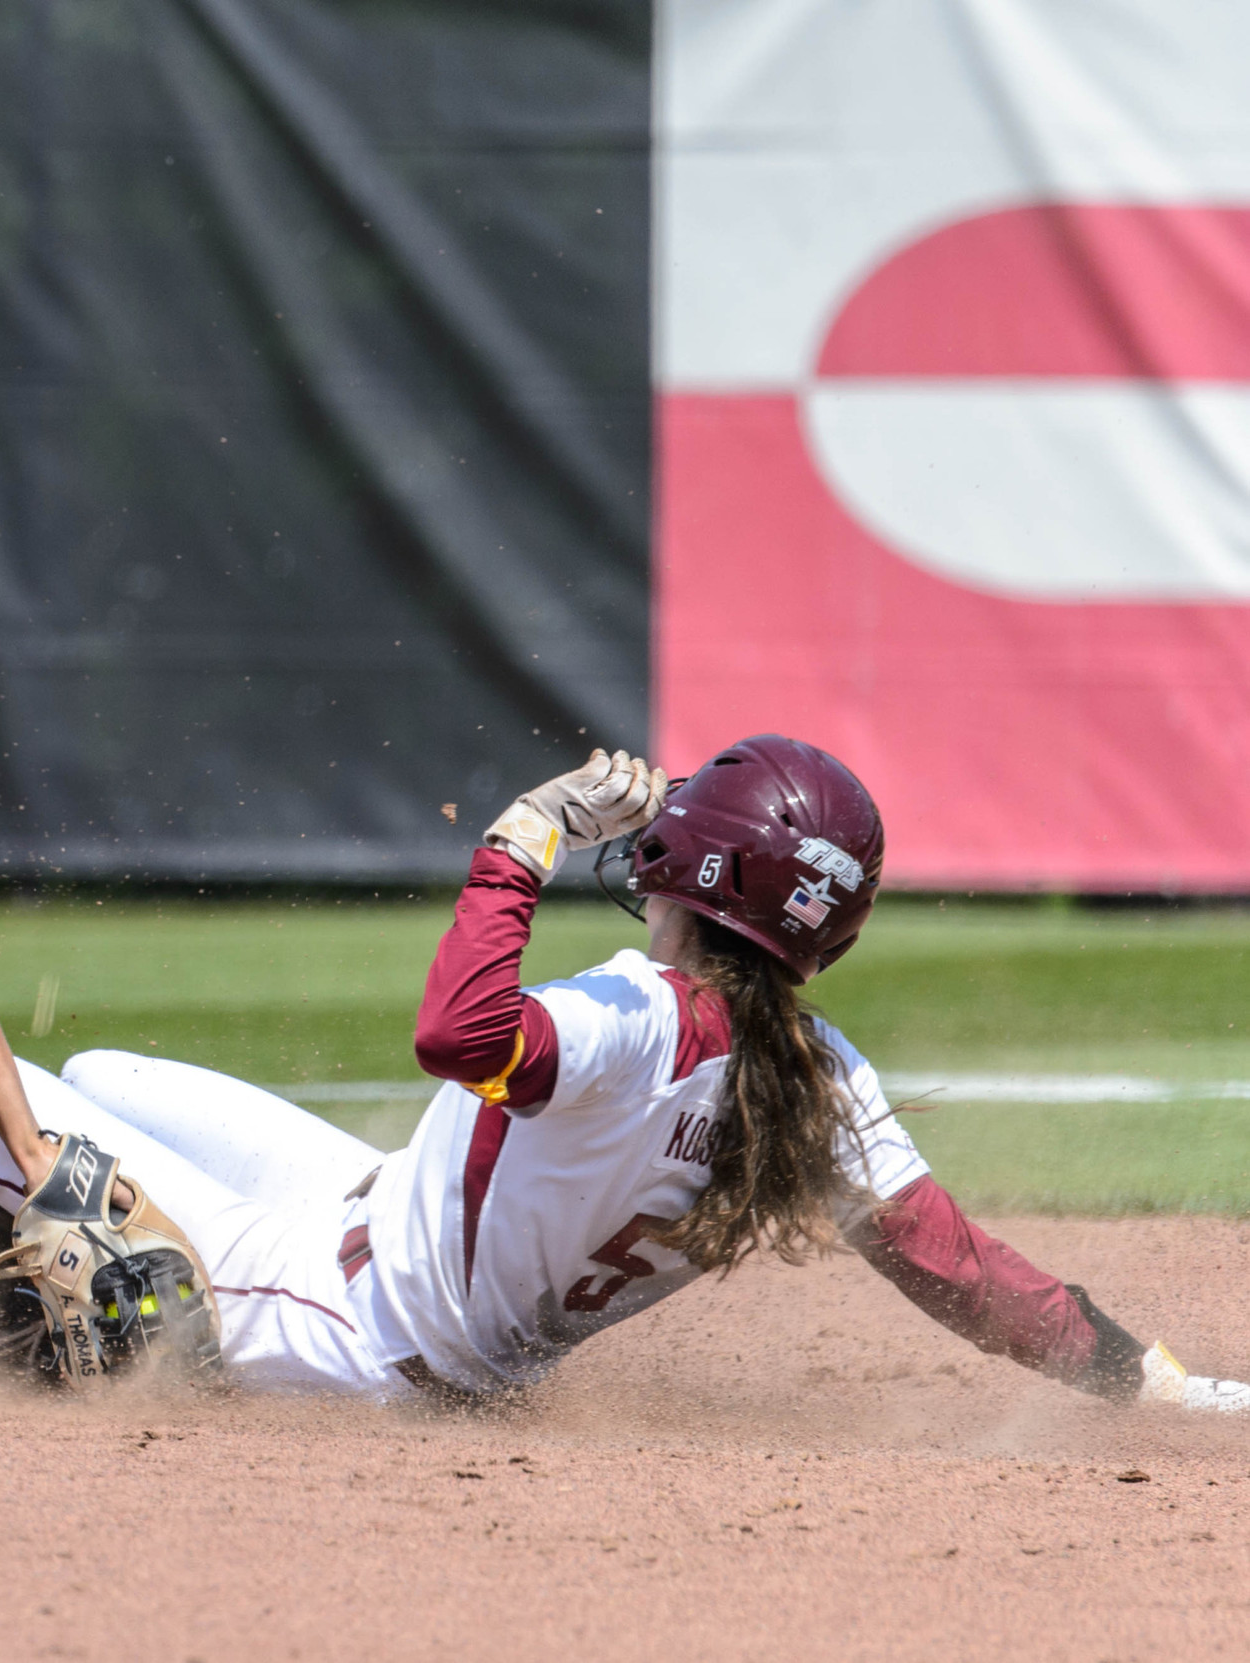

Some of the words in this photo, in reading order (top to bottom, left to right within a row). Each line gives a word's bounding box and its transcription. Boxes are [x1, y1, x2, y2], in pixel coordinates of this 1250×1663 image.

[698, 854, 722, 887] 5
[794, 837, 864, 893] TPS
[59, 1249, 79, 1271] 5
[563, 1213, 680, 1312] 5
[67, 1314, 96, 1376] THOMAS
